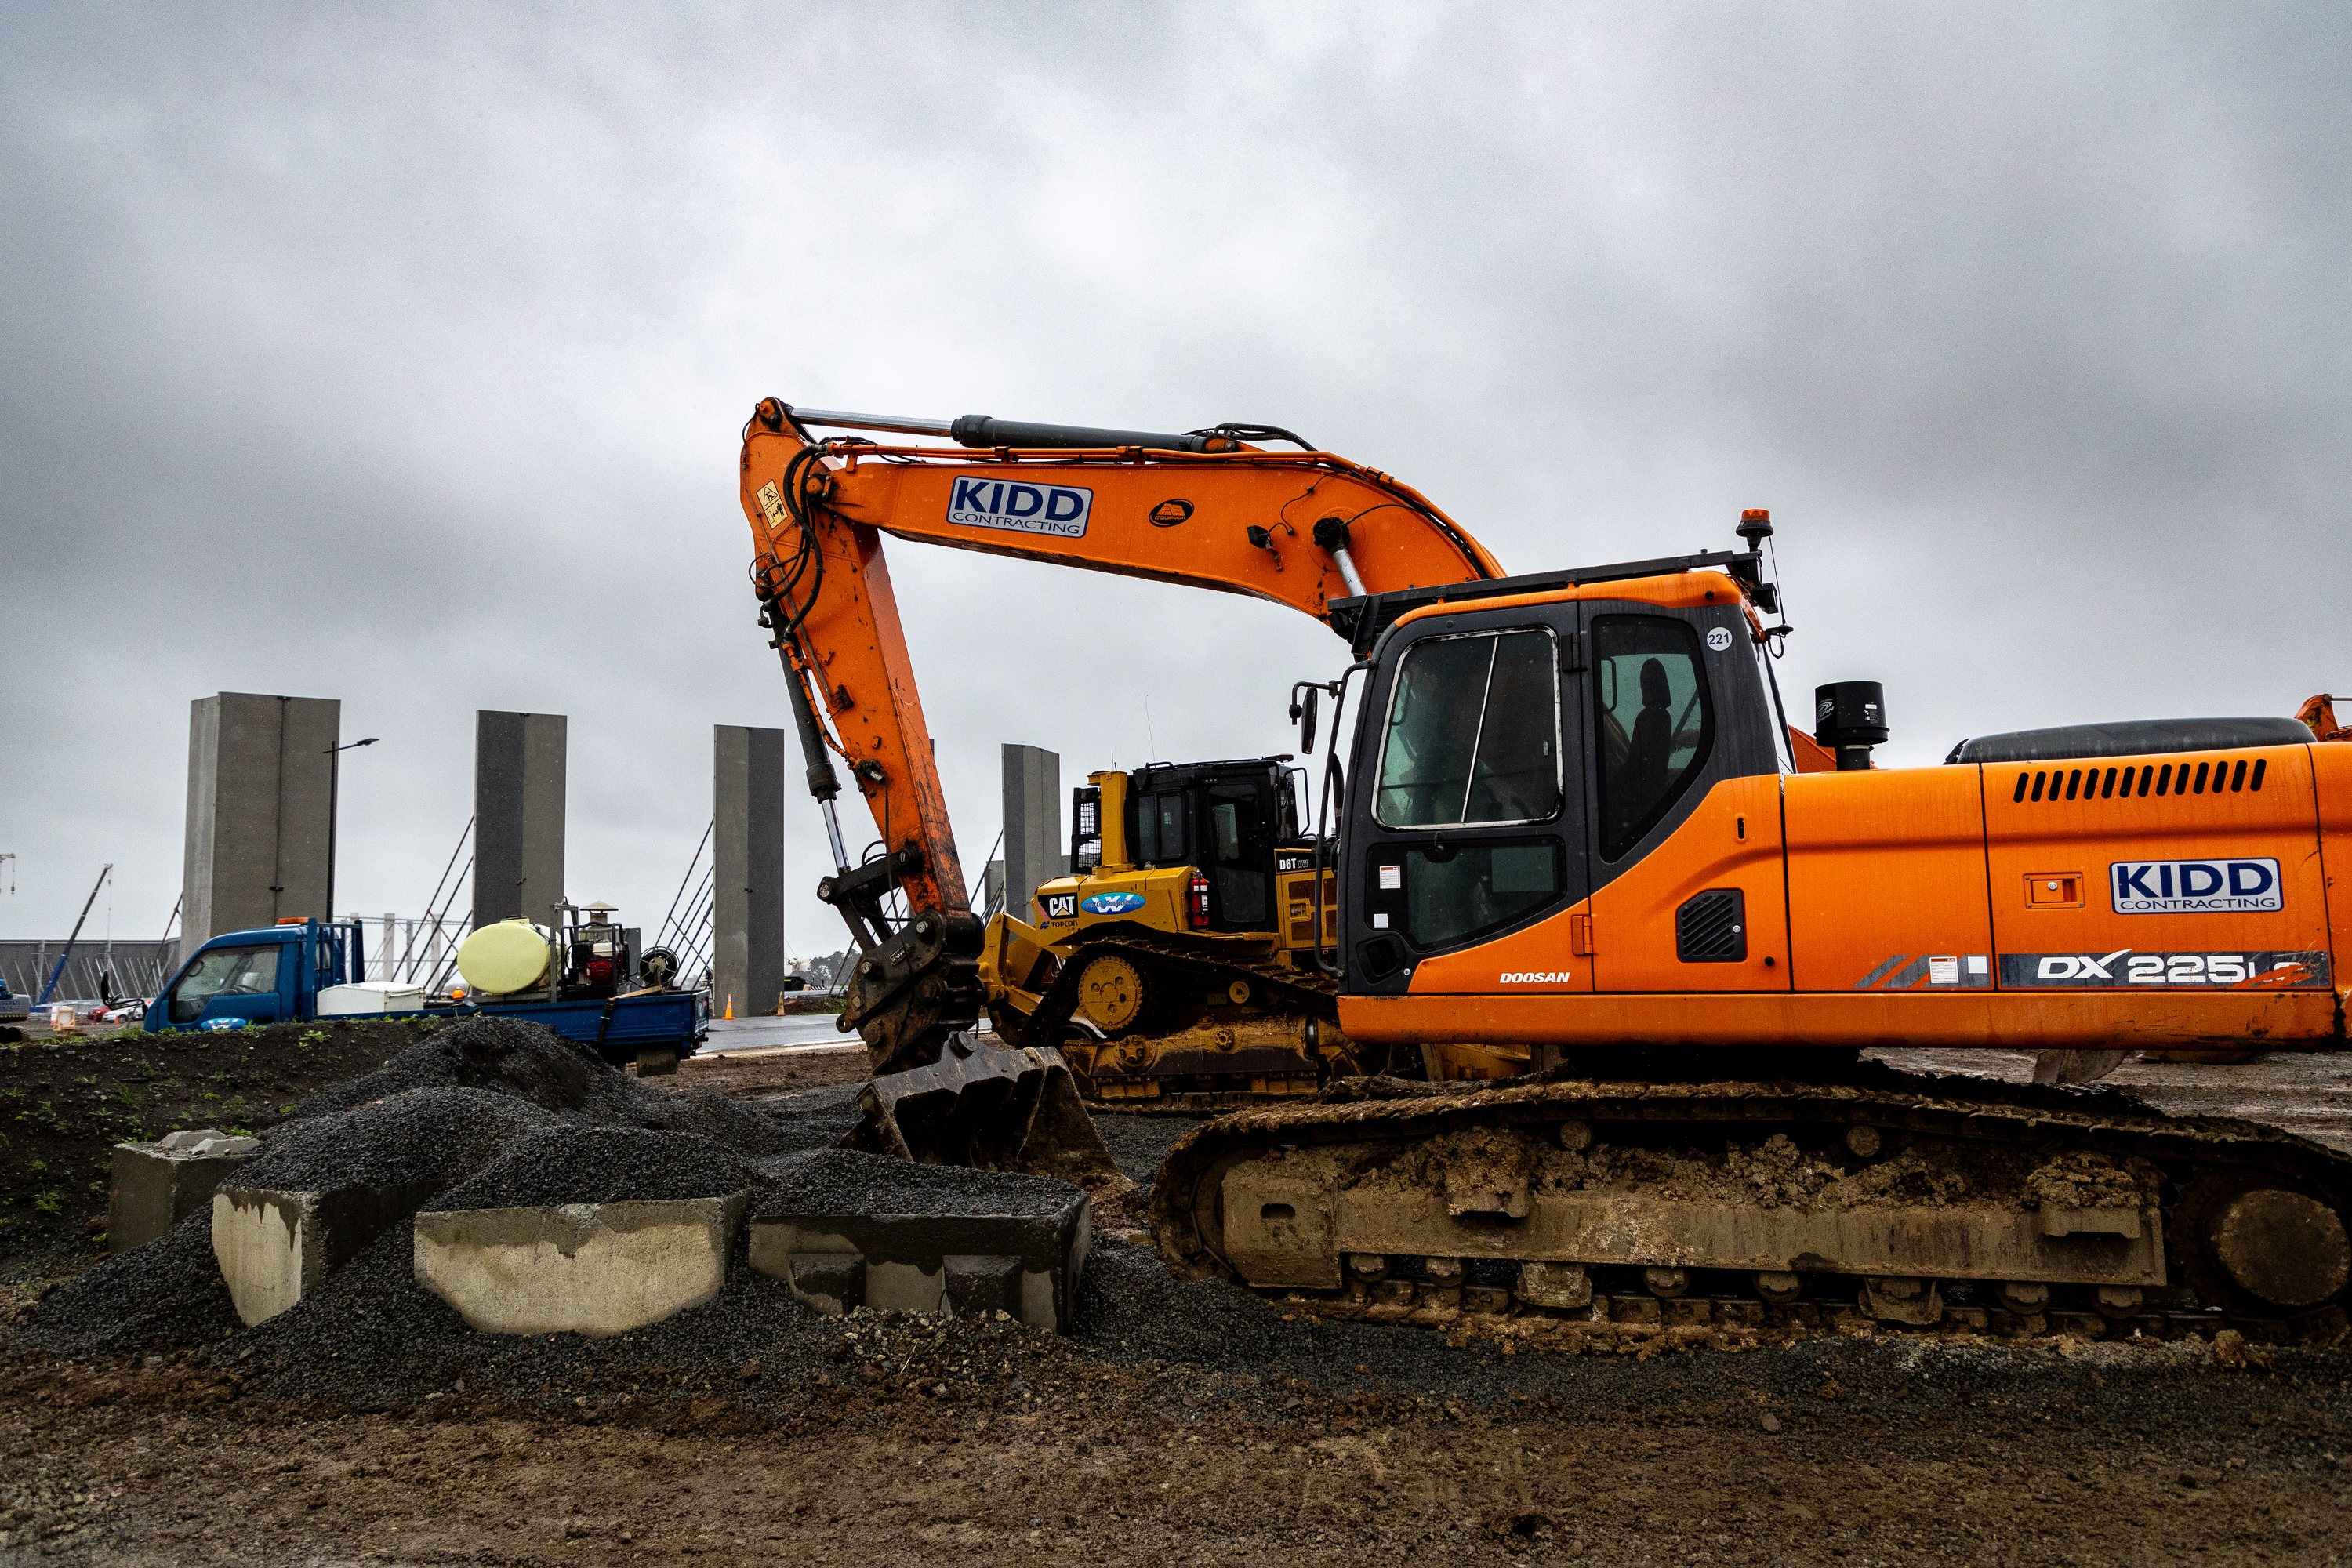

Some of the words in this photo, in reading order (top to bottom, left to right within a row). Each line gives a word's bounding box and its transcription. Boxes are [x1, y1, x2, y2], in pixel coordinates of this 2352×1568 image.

[954, 480, 1084, 521] KIDD
[953, 512, 1080, 534] CONTRACTING
[1708, 633, 1730, 644] 221
[1279, 858, 1297, 870] D6T
[2117, 862, 2273, 898] KIDD
[1049, 895, 1075, 916] CAT
[2120, 898, 2276, 910] CONTRACTING
[2037, 949, 2133, 979] DX
[1499, 972, 1570, 983] DOOSAN
